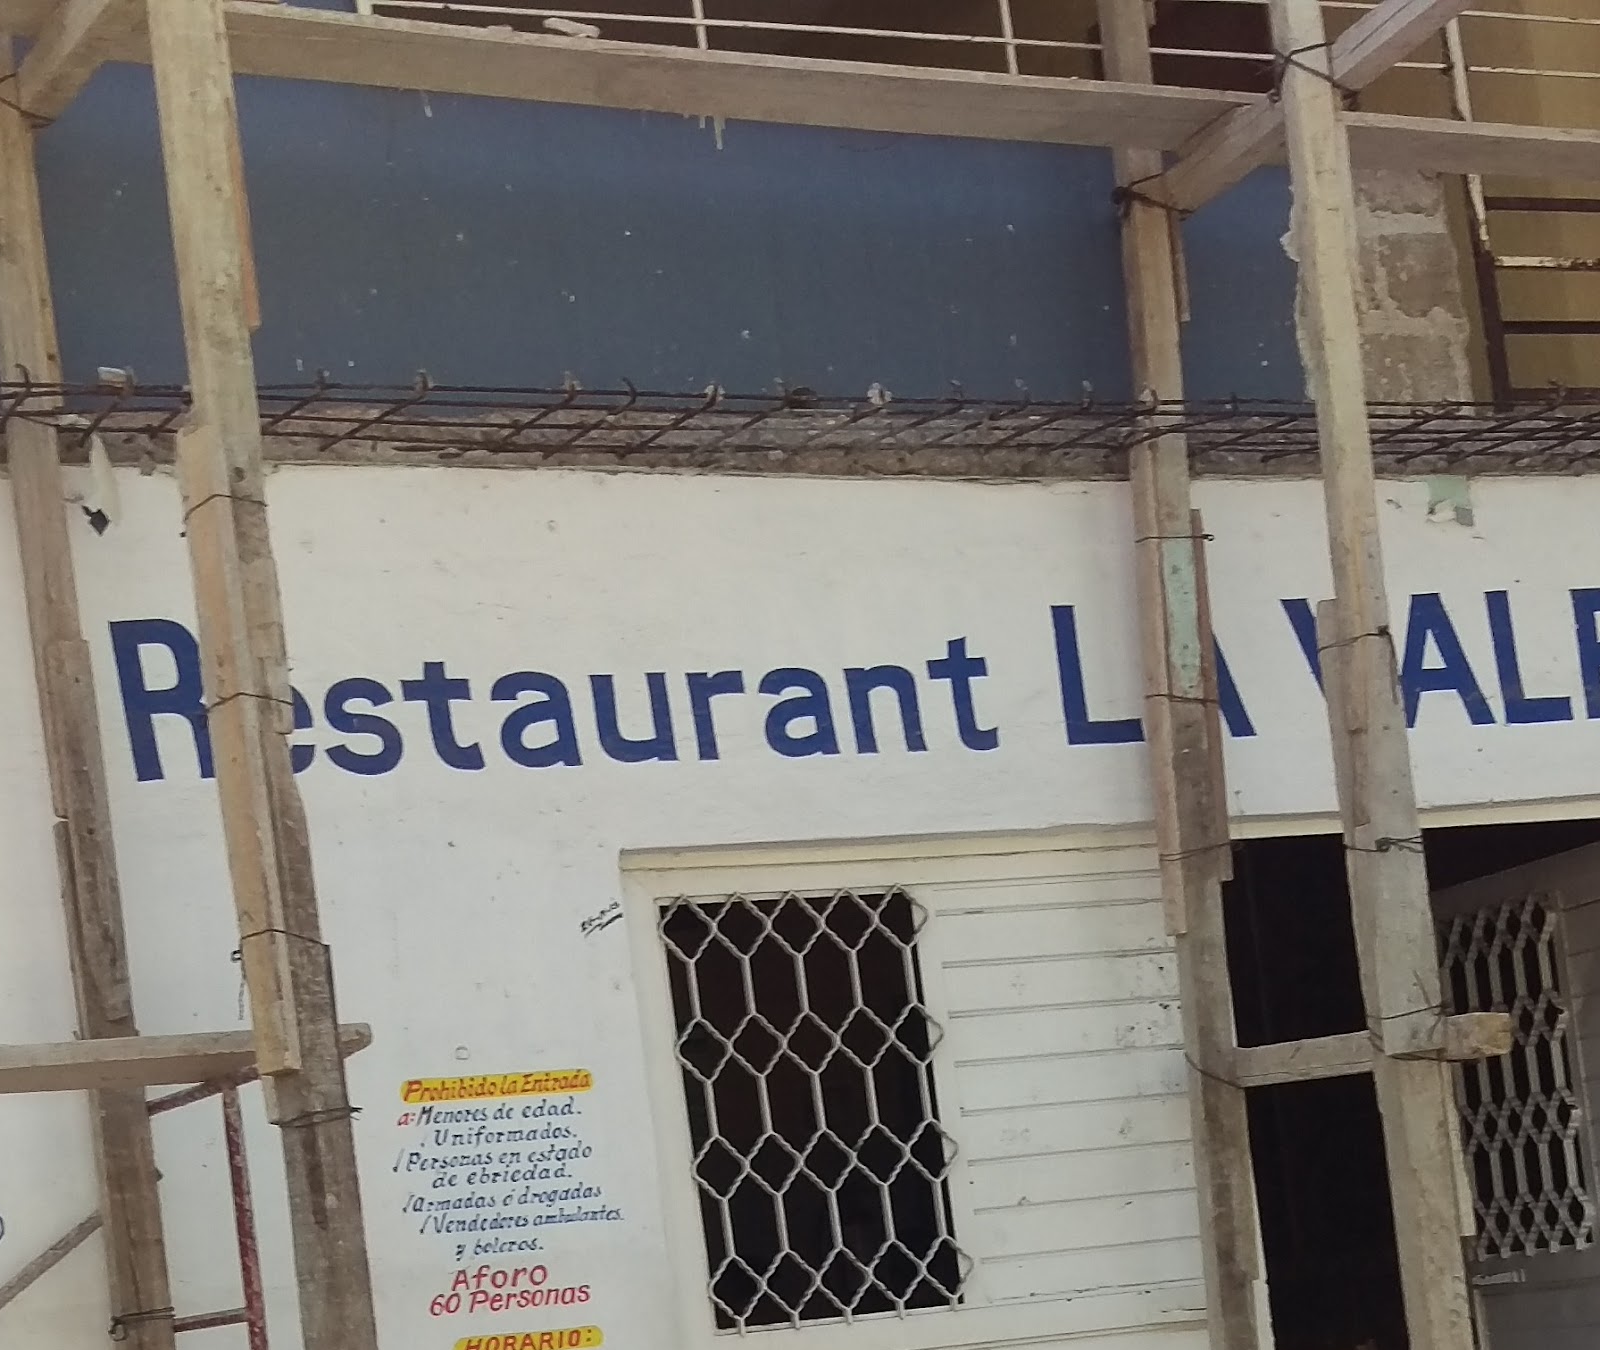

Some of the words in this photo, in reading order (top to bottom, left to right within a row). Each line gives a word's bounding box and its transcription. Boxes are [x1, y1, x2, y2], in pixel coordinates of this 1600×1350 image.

[404, 1076, 498, 1102] Prohibido
[500, 1075, 517, 1096] la
[416, 1105, 488, 1127] Menores
[493, 1102, 514, 1121] de
[521, 1096, 582, 1119] edad.
[434, 1122, 578, 1148] Uniformados.
[498, 1150, 520, 1165] en
[528, 1140, 592, 1164] estado
[432, 1172, 458, 1189] de
[467, 1163, 573, 1185] ebriedad.
[518, 1182, 602, 1208] drogadas
[455, 1243, 466, 1262] y
[473, 1237, 544, 1257] boleros.
[451, 1264, 548, 1292] Aforo
[428, 1292, 461, 1317] 60
[469, 1284, 591, 1313] Personas
